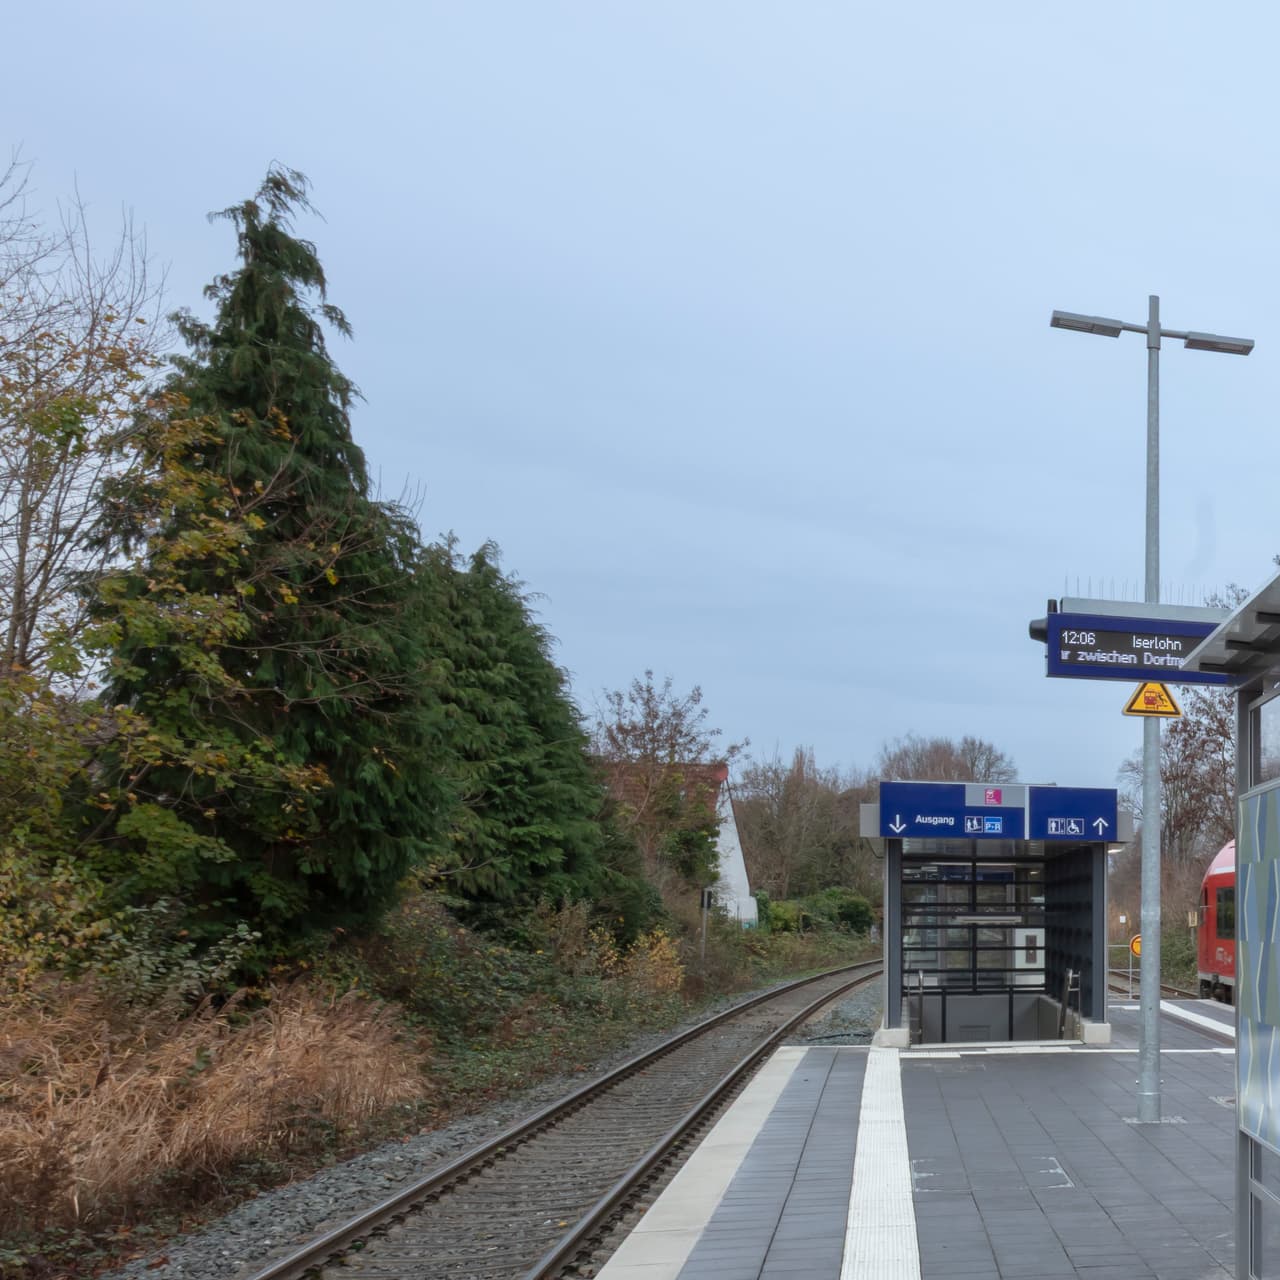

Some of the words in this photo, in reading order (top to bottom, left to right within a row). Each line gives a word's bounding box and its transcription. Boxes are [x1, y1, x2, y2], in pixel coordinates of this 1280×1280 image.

[1062, 630, 1096, 645] 12:06
[1132, 635, 1182, 650] Iserlohn
[1077, 649, 1137, 664] zwischen
[915, 815, 955, 825] Ausgang
